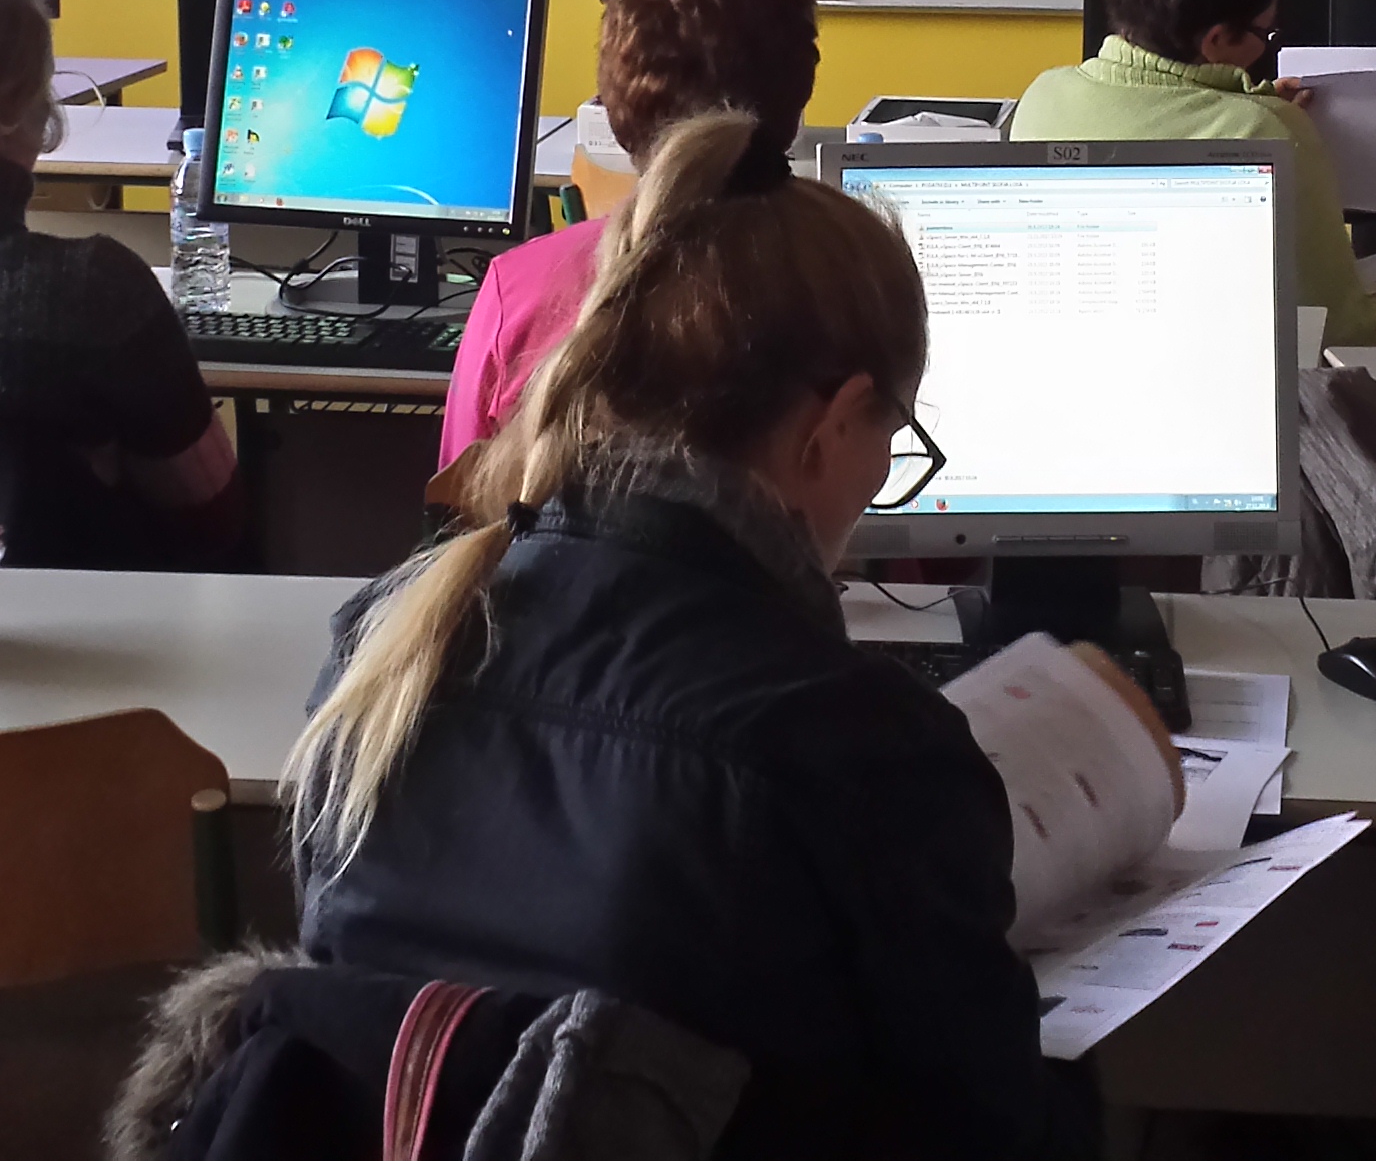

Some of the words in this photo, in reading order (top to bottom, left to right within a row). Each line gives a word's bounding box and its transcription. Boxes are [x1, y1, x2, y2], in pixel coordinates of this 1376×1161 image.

[841, 153, 869, 162] NEC
[1053, 146, 1081, 161] S02
[343, 216, 372, 227] DELL
